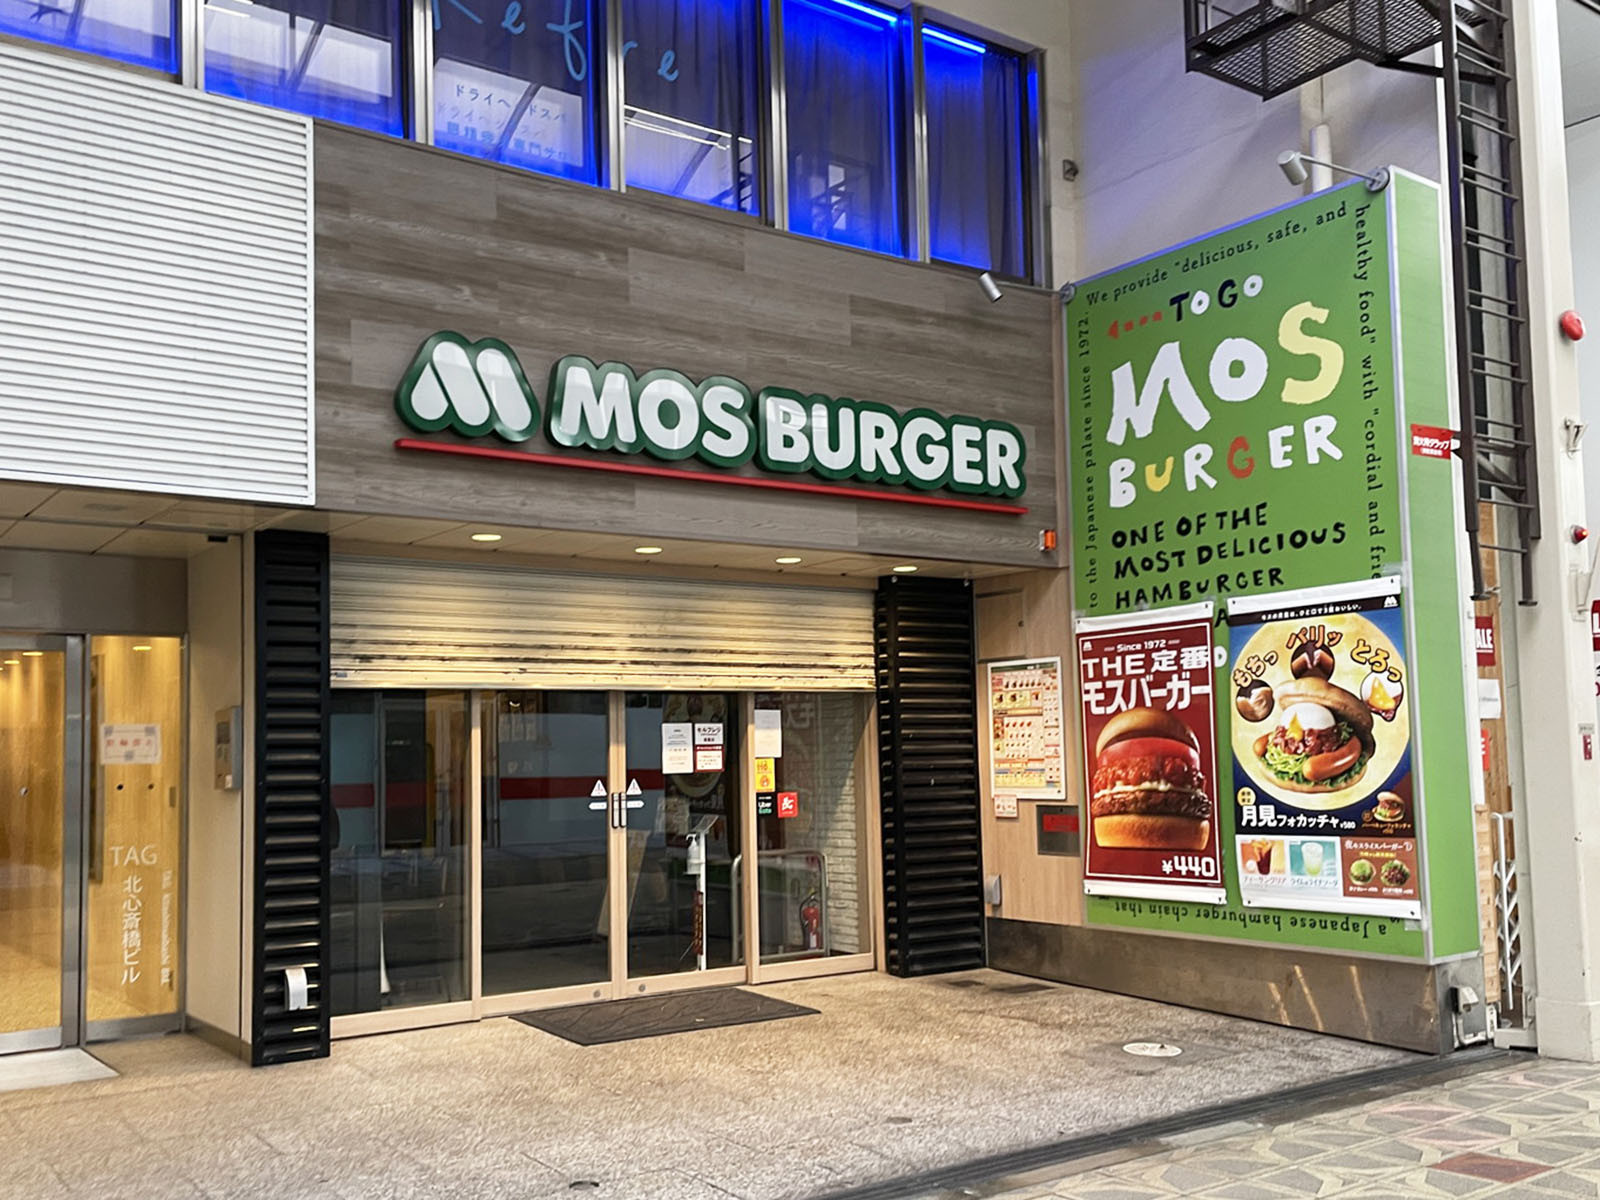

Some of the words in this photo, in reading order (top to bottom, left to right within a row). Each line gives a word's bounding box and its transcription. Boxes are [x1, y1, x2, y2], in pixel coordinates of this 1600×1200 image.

[1086, 290, 1108, 307] We
[1114, 268, 1168, 302] provide
[1267, 220, 1307, 244] safe,
[1316, 200, 1347, 226] and
[1354, 203, 1374, 282] healthy
[1080, 366, 1092, 409] since
[1105, 301, 1344, 446] MOS
[1362, 355, 1379, 401] with
[556, 365, 751, 460] MOS
[764, 395, 1021, 491] BURGER
[1081, 416, 1098, 469] palate
[1109, 415, 1343, 508] BURGER
[1084, 476, 1099, 551] Japanese
[1111, 521, 1165, 549] ONE
[1176, 513, 1207, 536] OF
[1215, 502, 1268, 530] THE
[1368, 501, 1385, 536] and
[1085, 558, 1098, 584] the
[1114, 551, 1185, 580] MOST
[1196, 522, 1346, 566] DELICIOUS
[1086, 592, 1099, 608] to
[1115, 567, 1284, 610] HAMBURGER
[1116, 643, 1142, 653] Since
[1144, 639, 1167, 649] 1972
[1286, 625, 1343, 649] パリッ
[1081, 653, 1146, 679] THE
[1150, 645, 1210, 673] 定番
[1233, 650, 1279, 688] もちっ
[1350, 638, 1403, 682] とろっ
[1083, 671, 1211, 716] モスバーガー
[1241, 805, 1339, 829] 月見フォカッチャ
[110, 844, 158, 867] TAG
[1161, 856, 1217, 878] ¥440
[1115, 901, 1143, 918] that
[1149, 904, 1188, 922] chain
[1196, 908, 1281, 932] hamburger
[1290, 916, 1370, 939] Japanese
